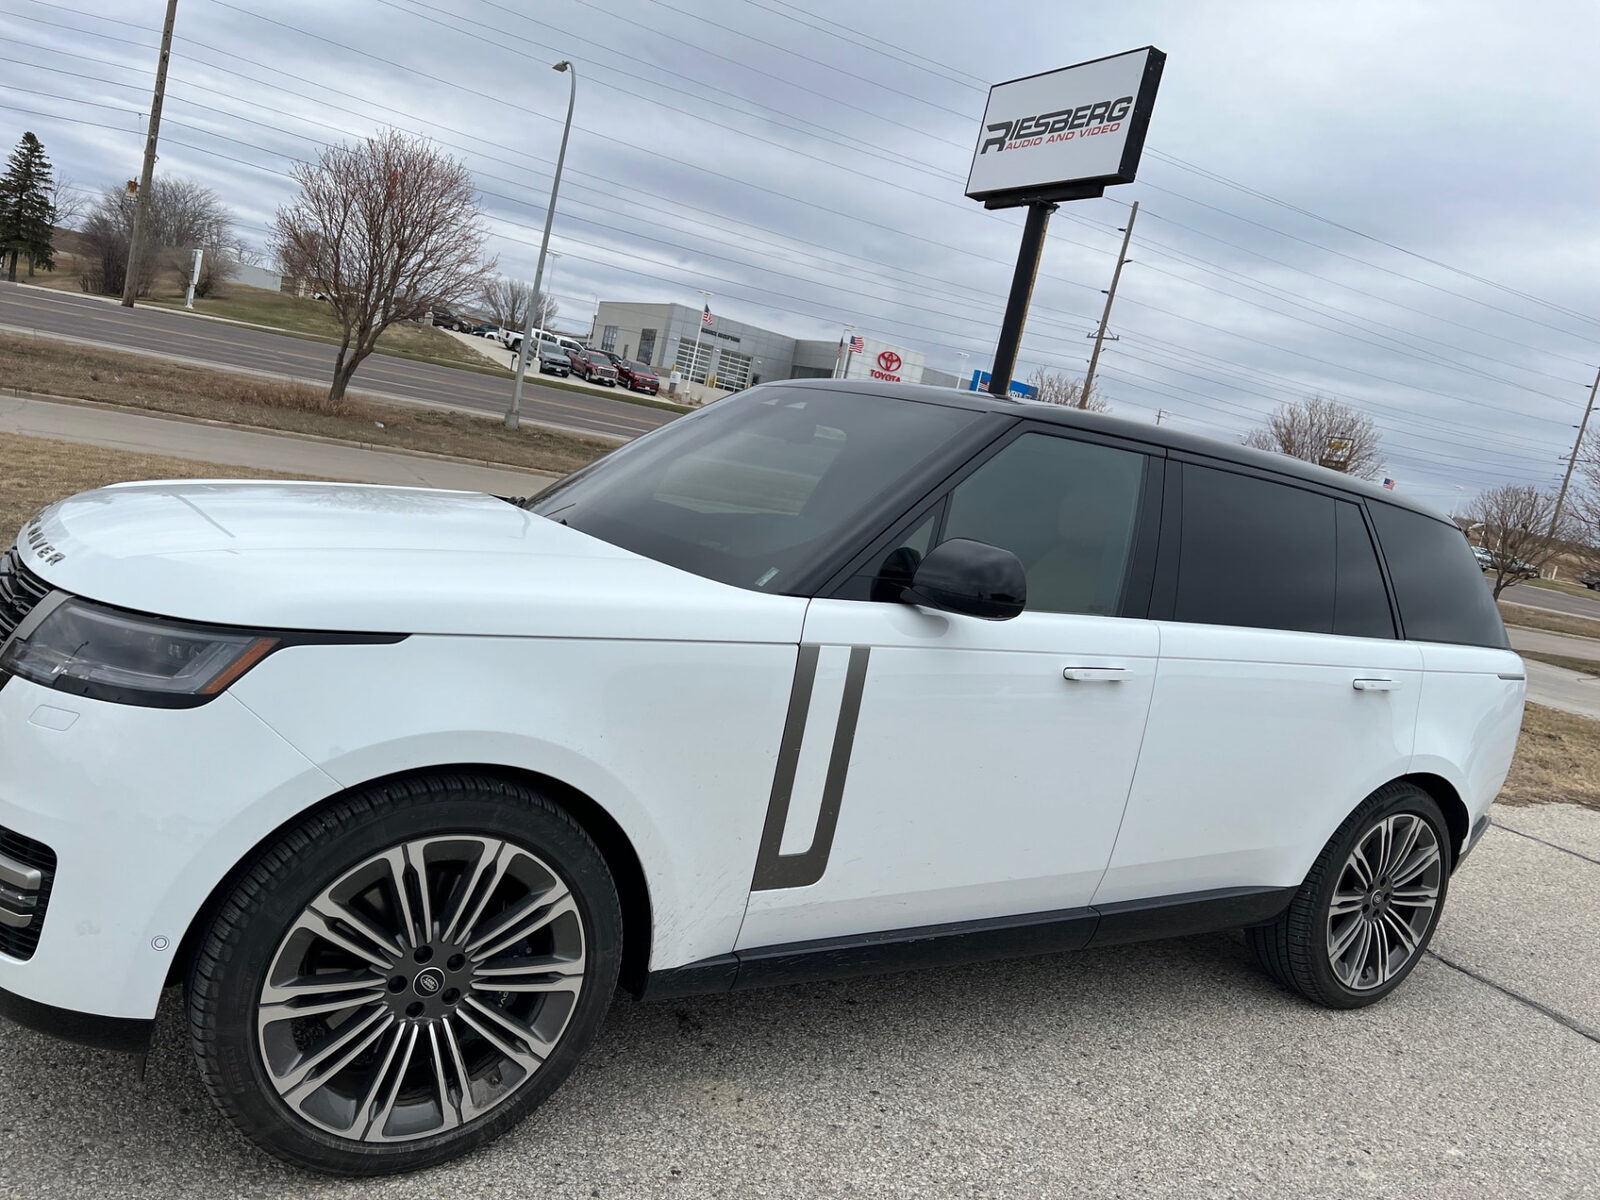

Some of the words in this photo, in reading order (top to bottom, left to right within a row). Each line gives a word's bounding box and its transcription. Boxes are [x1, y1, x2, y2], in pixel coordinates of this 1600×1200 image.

[980, 96, 1133, 155] RIESBERG
[1004, 137, 1043, 151] AUDIO
[1046, 131, 1075, 144] AND
[1080, 122, 1121, 138] VIDEO
[870, 369, 901, 383] TOYOTA
